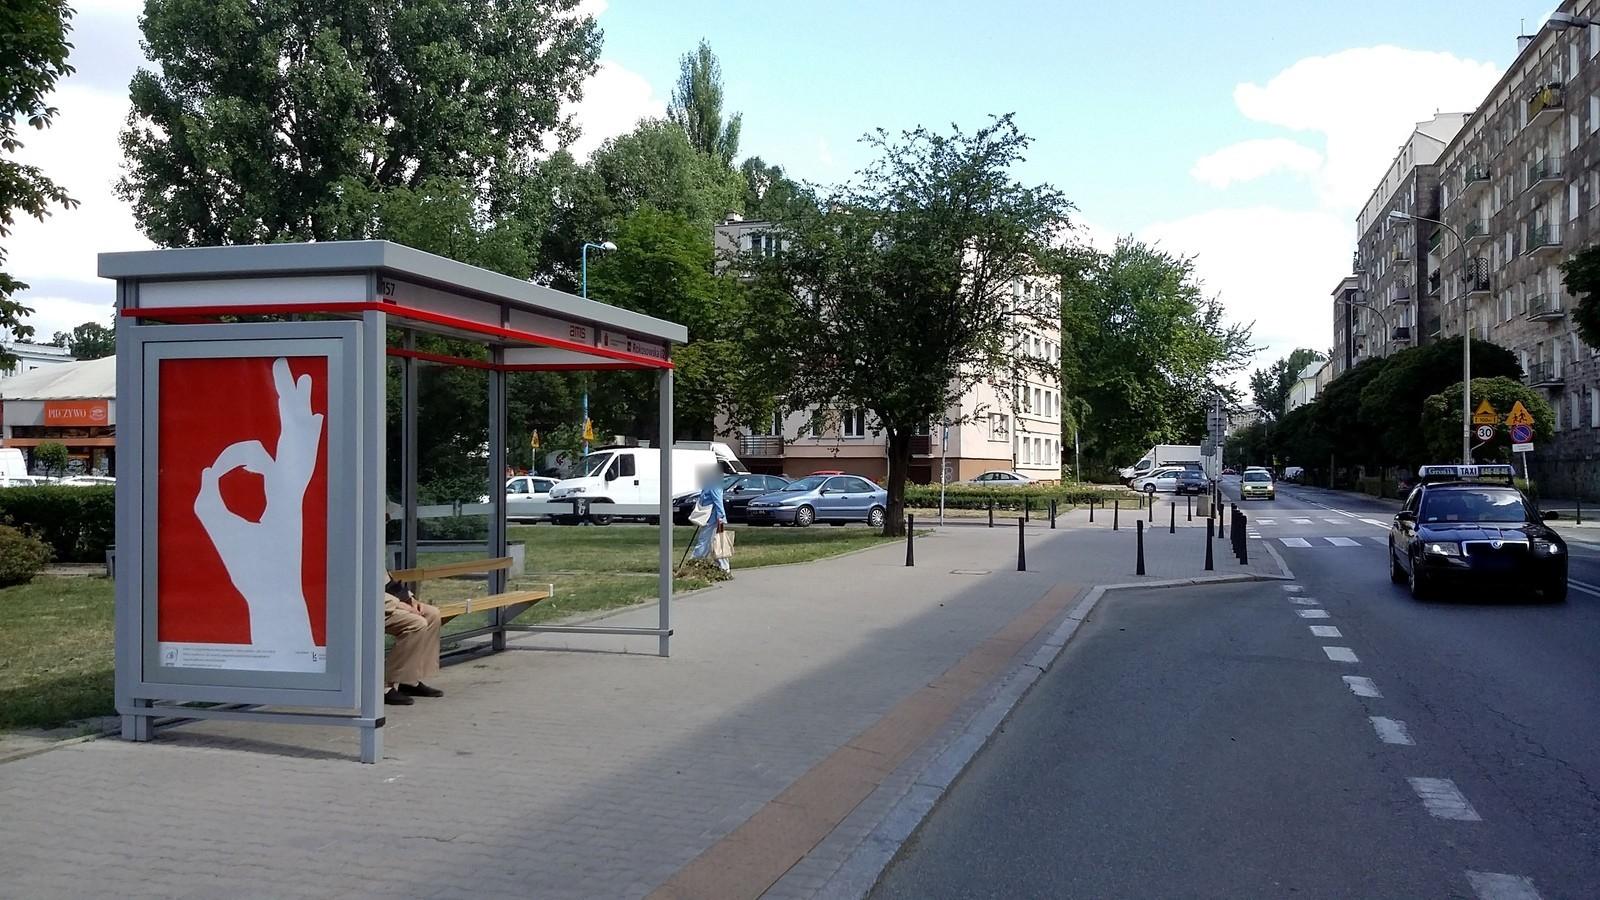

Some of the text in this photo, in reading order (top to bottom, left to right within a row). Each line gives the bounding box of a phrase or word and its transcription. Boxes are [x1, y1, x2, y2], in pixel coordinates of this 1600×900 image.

[569, 325, 586, 339] ams
[48, 408, 87, 419] PIECZYWO
[1479, 428, 1492, 437] 30
[1460, 467, 1477, 475] TAXI
